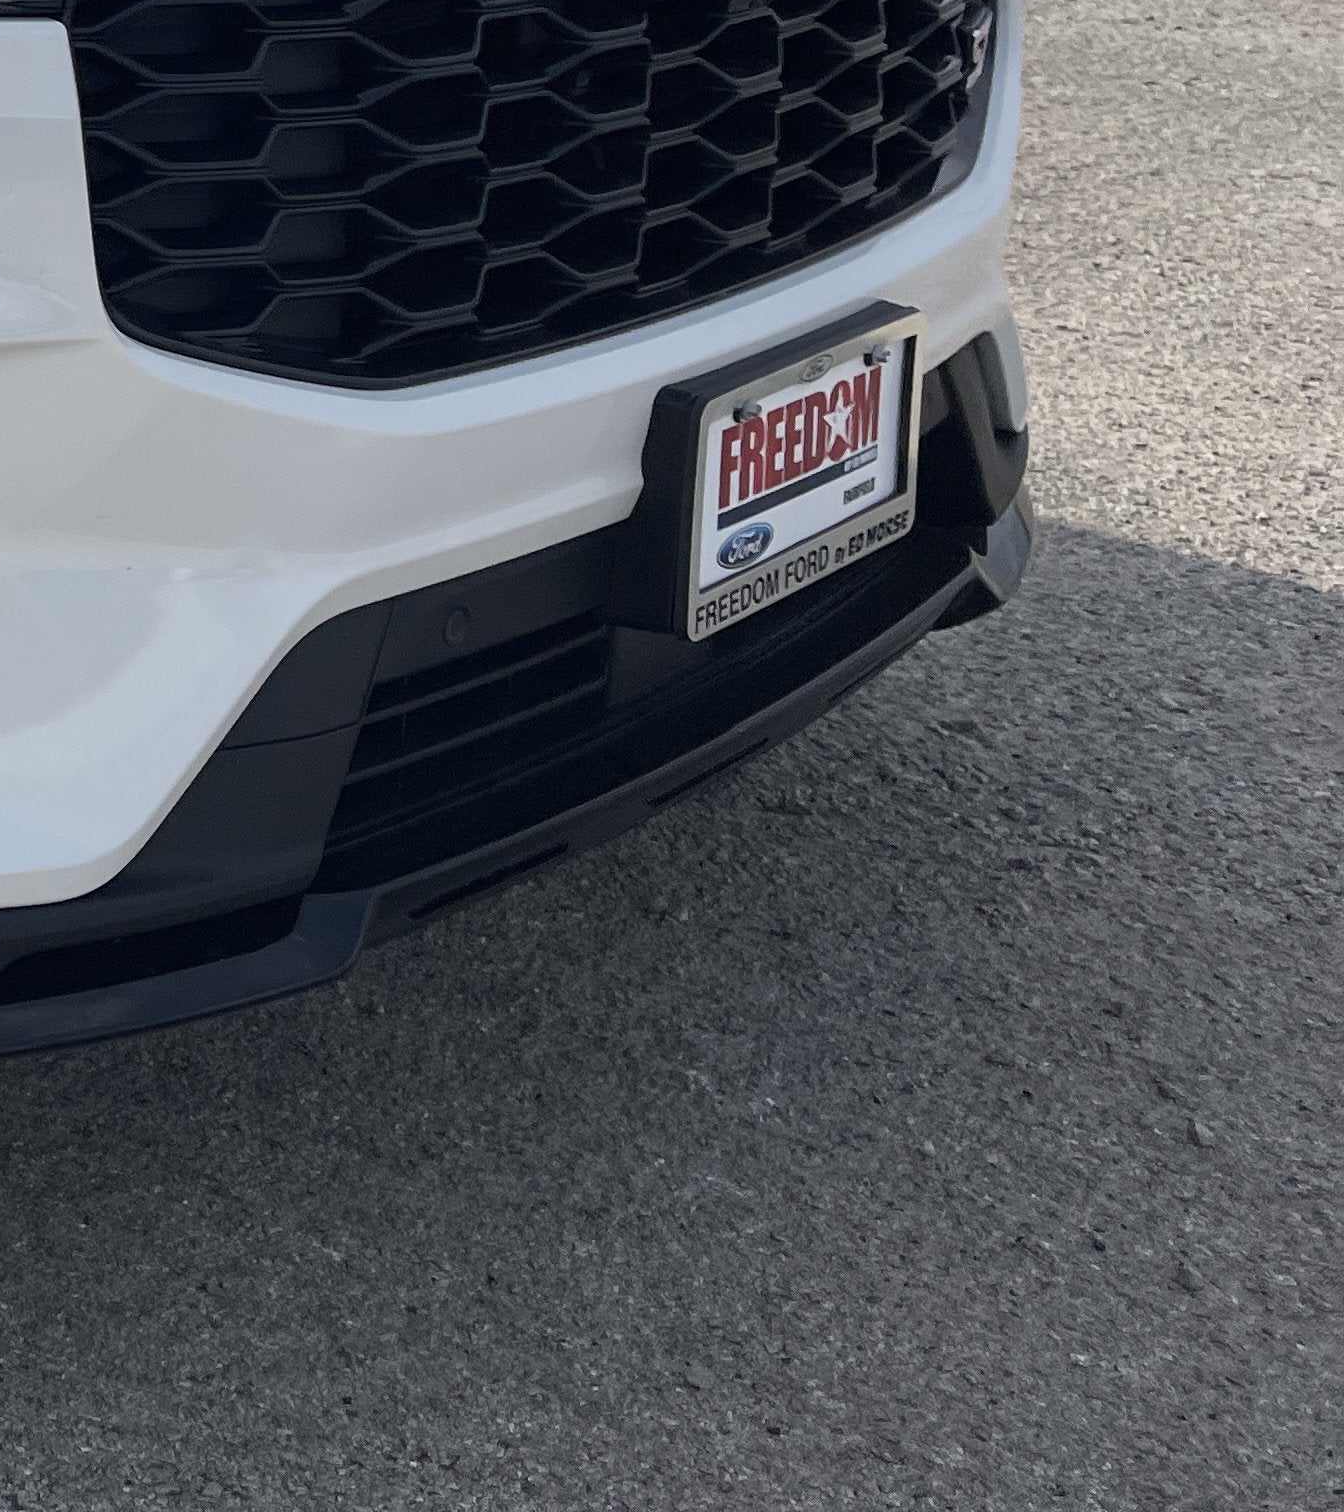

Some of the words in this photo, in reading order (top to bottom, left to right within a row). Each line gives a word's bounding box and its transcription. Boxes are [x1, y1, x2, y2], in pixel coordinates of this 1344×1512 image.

[718, 367, 882, 510] FREEDOM
[694, 570, 780, 635] FREEDOM
[784, 545, 830, 590] FORD
[727, 530, 765, 564] Ford
